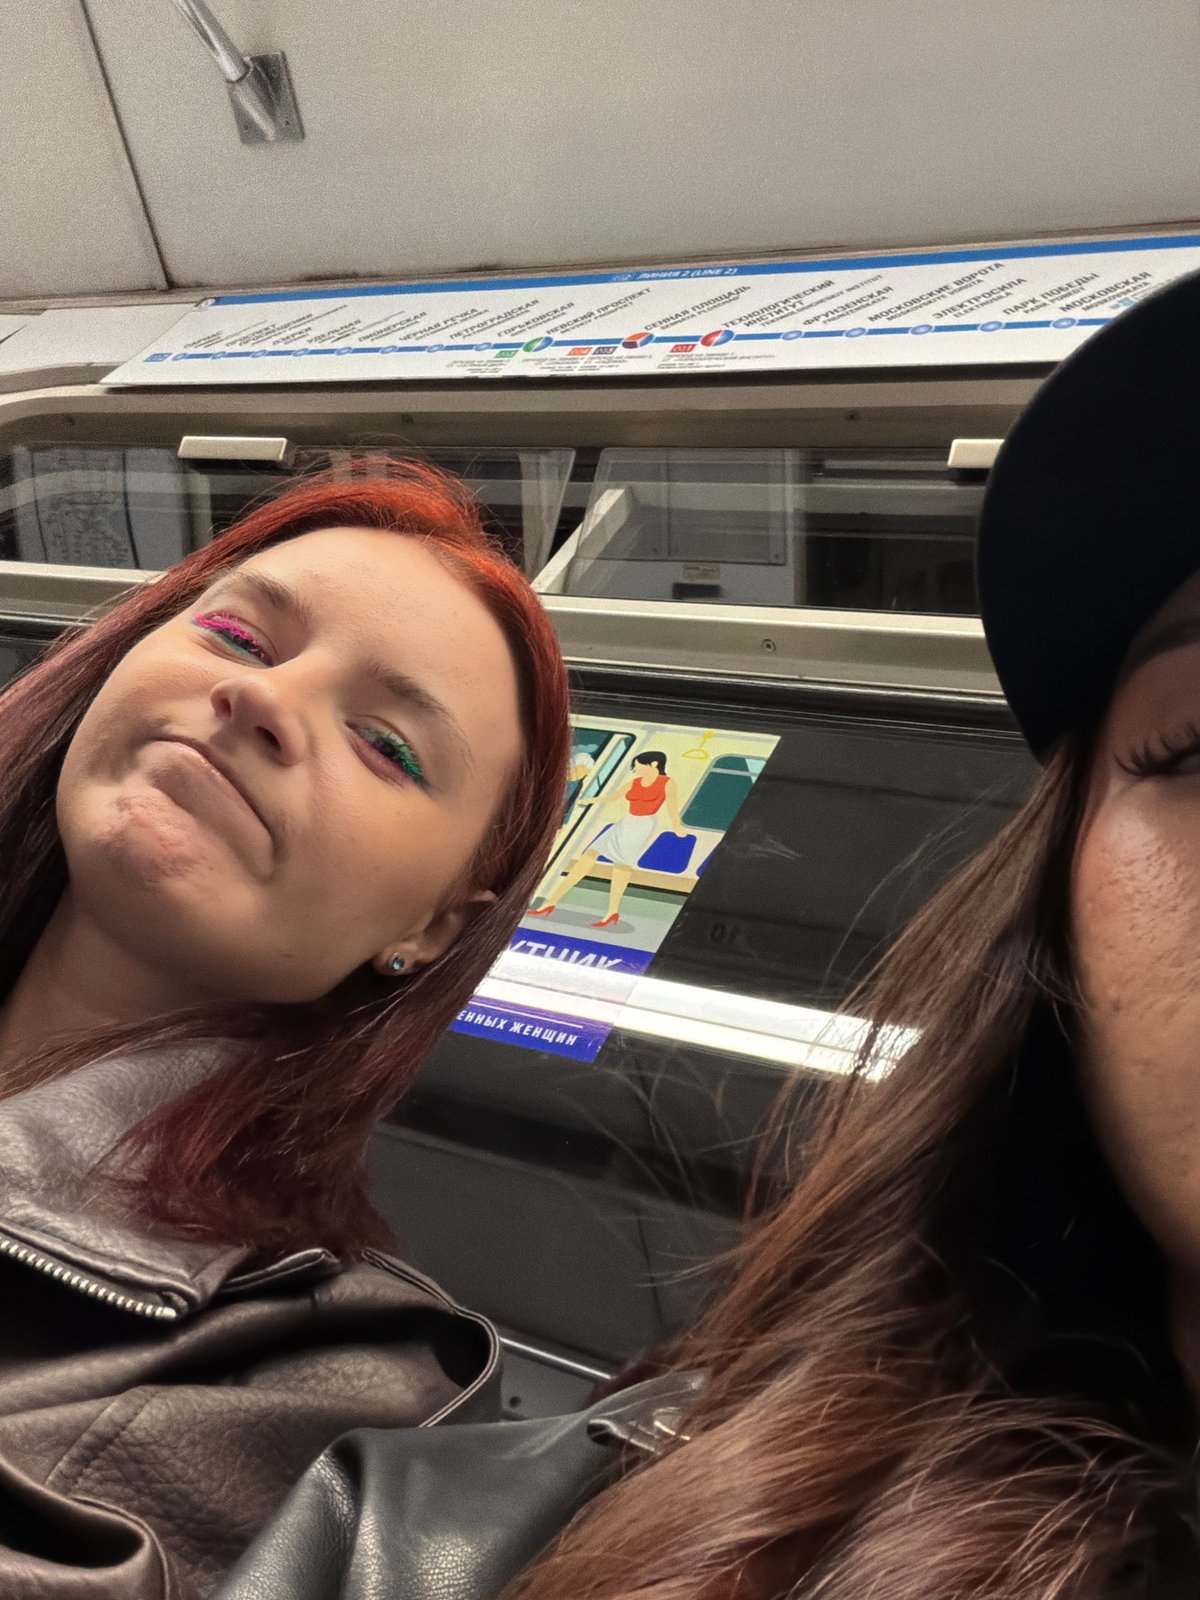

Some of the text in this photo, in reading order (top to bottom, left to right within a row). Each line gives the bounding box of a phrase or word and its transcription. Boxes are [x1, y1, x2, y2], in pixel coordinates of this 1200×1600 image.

[690, 268, 723, 277] (LINE
[867, 262, 1005, 322] МОСКОВСКИЕ ВОРОТА
[1059, 271, 1152, 312] МОСКОВСКАЯ
[546, 310, 595, 335] НЕВСКИЙ
[596, 287, 652, 315] ПРОСПЕКТ
[644, 285, 751, 332] СЕННАЯ ПЛОЩАДЬ
[722, 280, 835, 328] ТЕХНОЛОГИЧЕСКИЙ
[743, 300, 805, 327] ИНСТИТУТ
[803, 286, 894, 326] ФРУНЗЕНСКАЯ
[932, 278, 1028, 319] ЭЛЕКТРОСИЛА
[1002, 272, 1100, 315] ПАРК ПОБЕДЫ
[450, 299, 540, 340] ПЕТРОГРАДСКАЯ
[497, 302, 575, 338] ГОРЬКОВСКАЯ
[509, 1021, 577, 1046] ЖЕНЩИН
